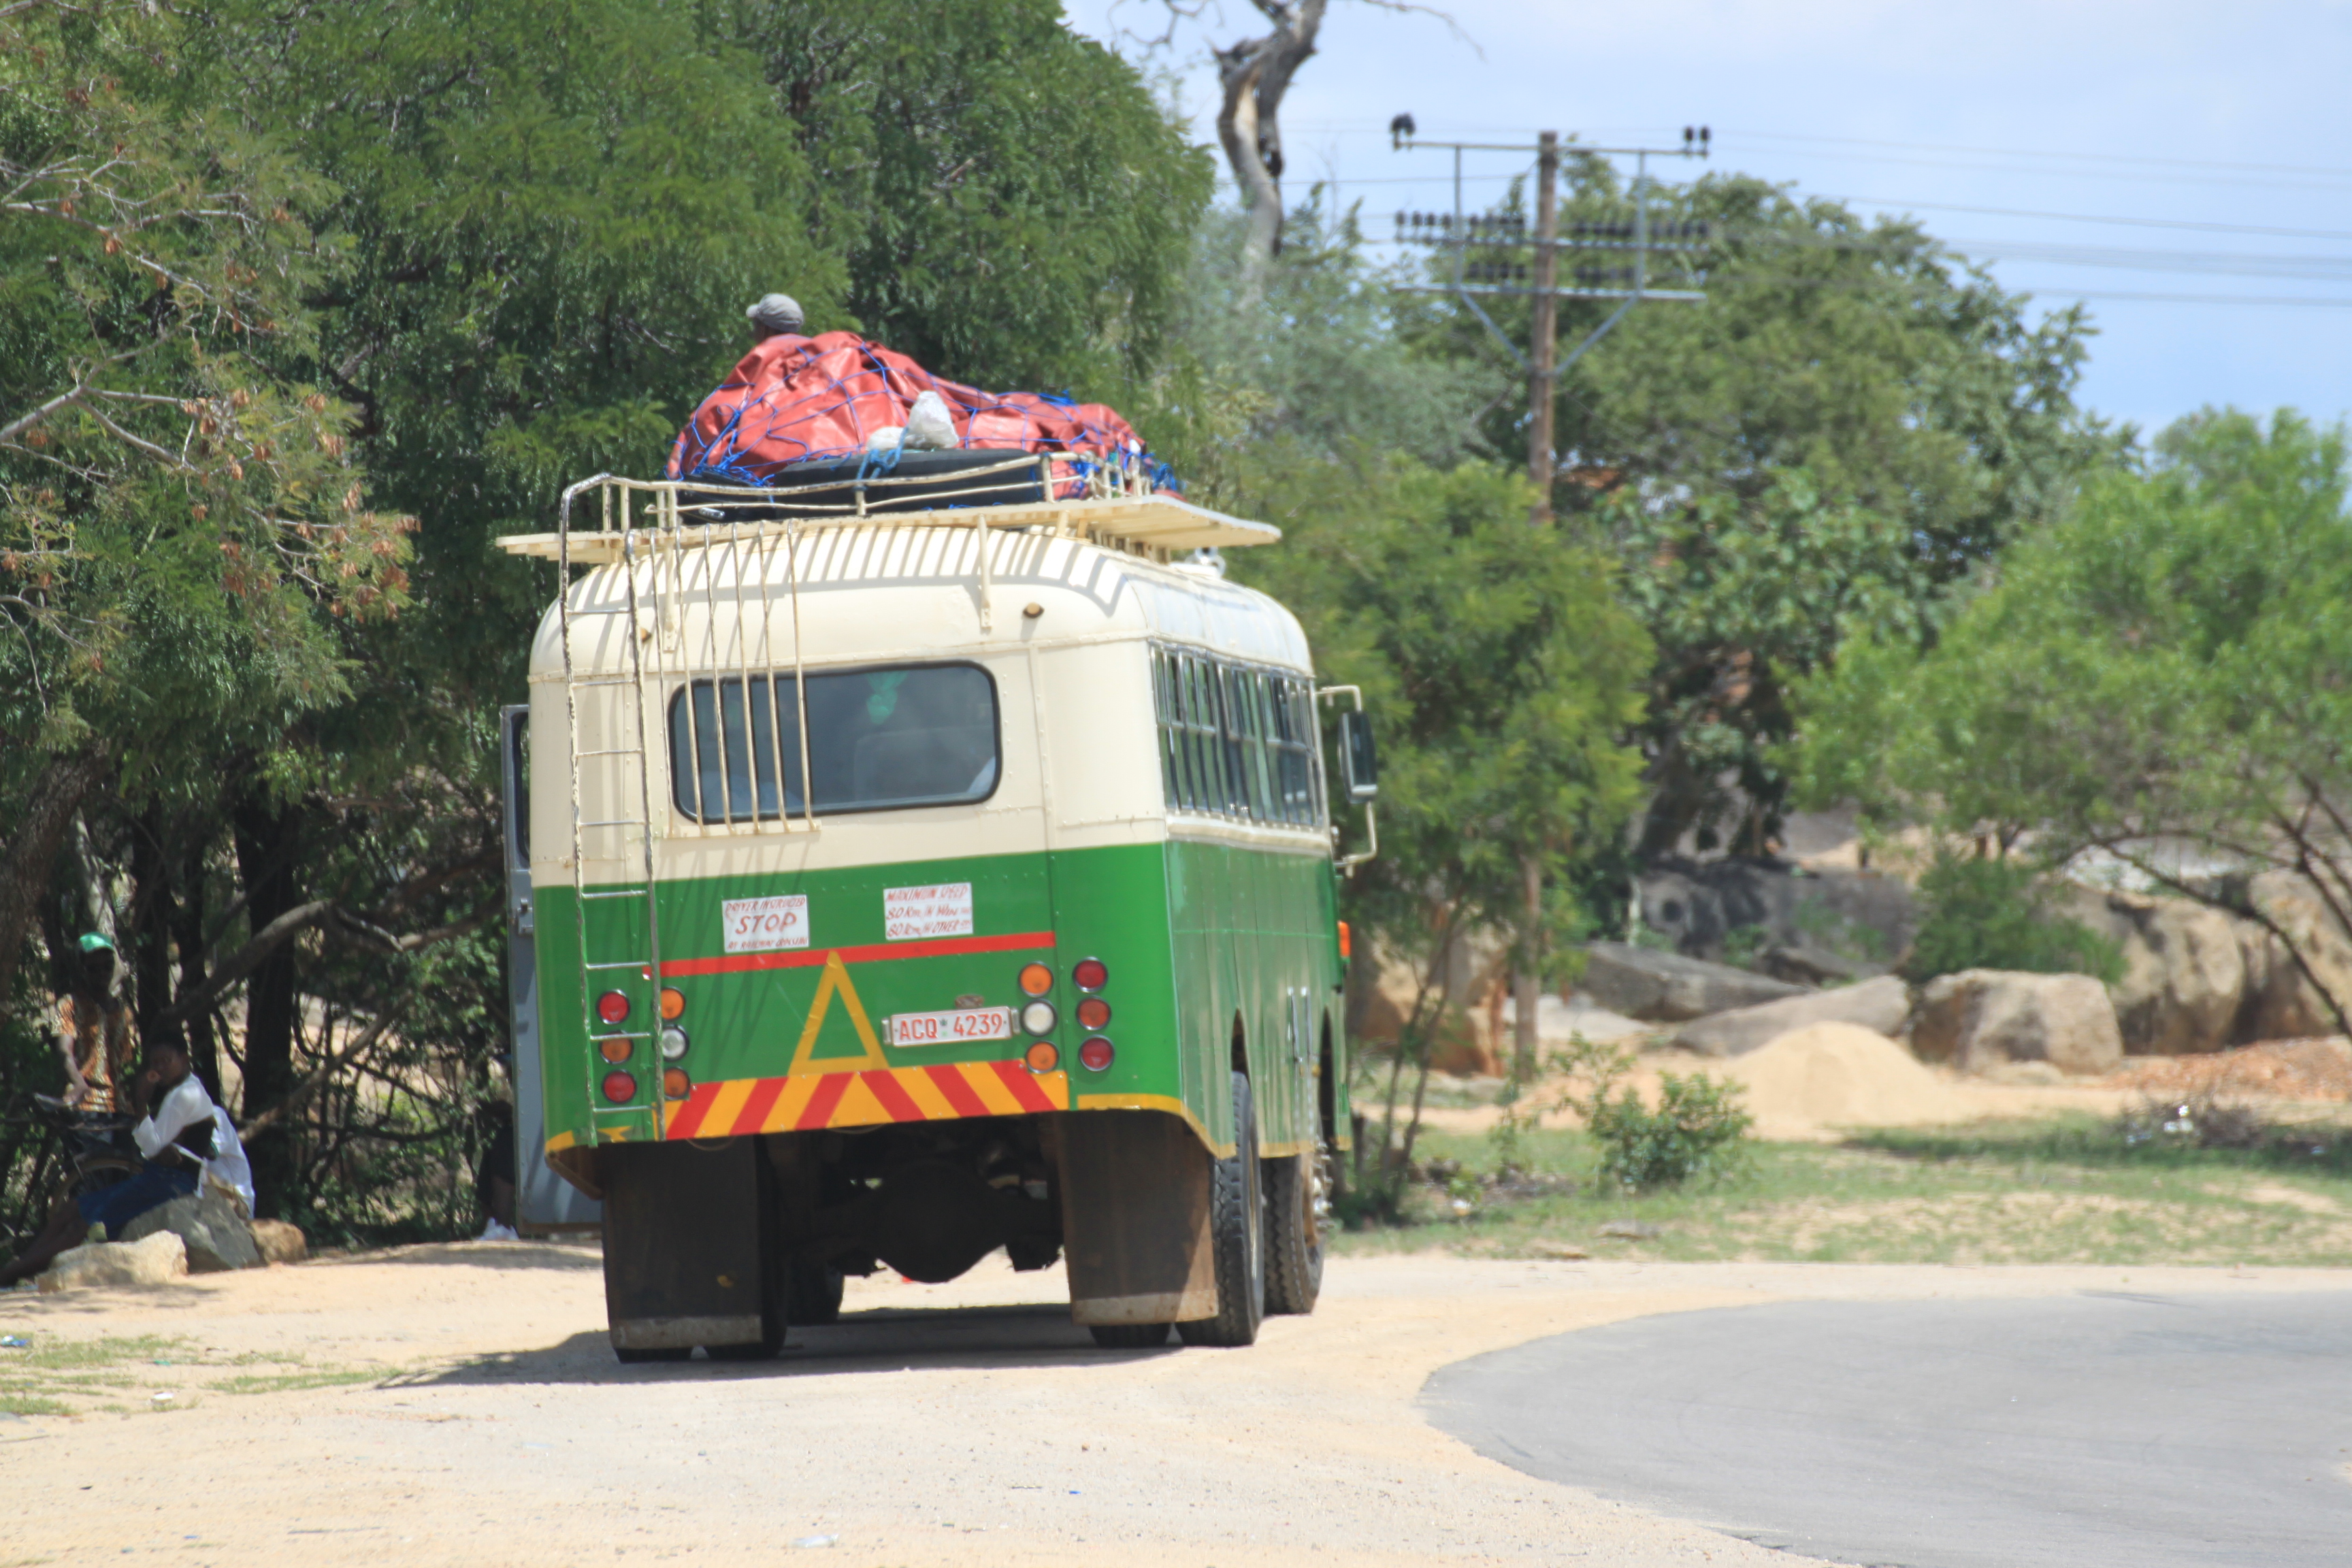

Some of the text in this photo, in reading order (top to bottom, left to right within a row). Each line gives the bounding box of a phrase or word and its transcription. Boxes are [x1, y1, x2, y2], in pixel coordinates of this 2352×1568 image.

[725, 900, 758, 913] DRIVER
[735, 912, 797, 934] STOP
[900, 1013, 1003, 1041] ACQ 4239
